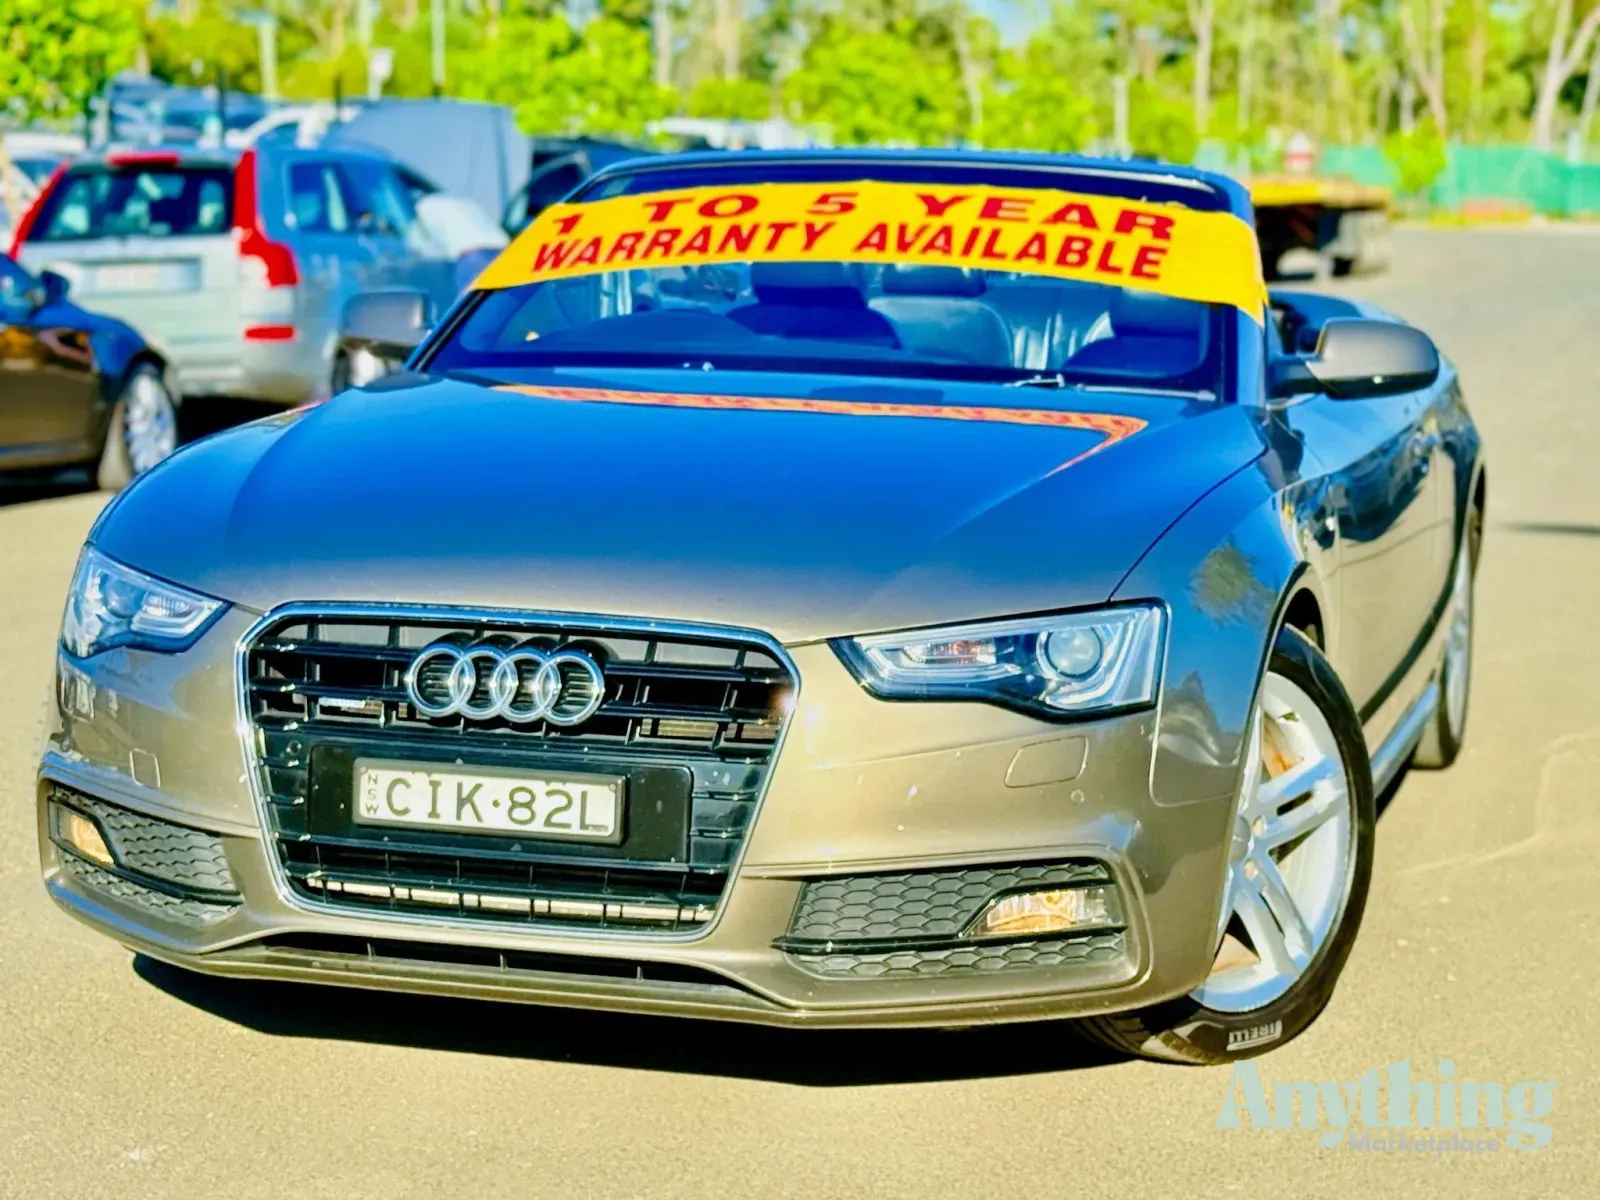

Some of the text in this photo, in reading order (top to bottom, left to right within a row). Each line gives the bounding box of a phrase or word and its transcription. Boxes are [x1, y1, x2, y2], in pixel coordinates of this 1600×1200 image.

[552, 192, 1176, 241] 1 TO 5 YEAR
[533, 222, 1169, 280] WARRANTY AVAILABLE
[1226, 1020, 1283, 1051] PIRELLI
